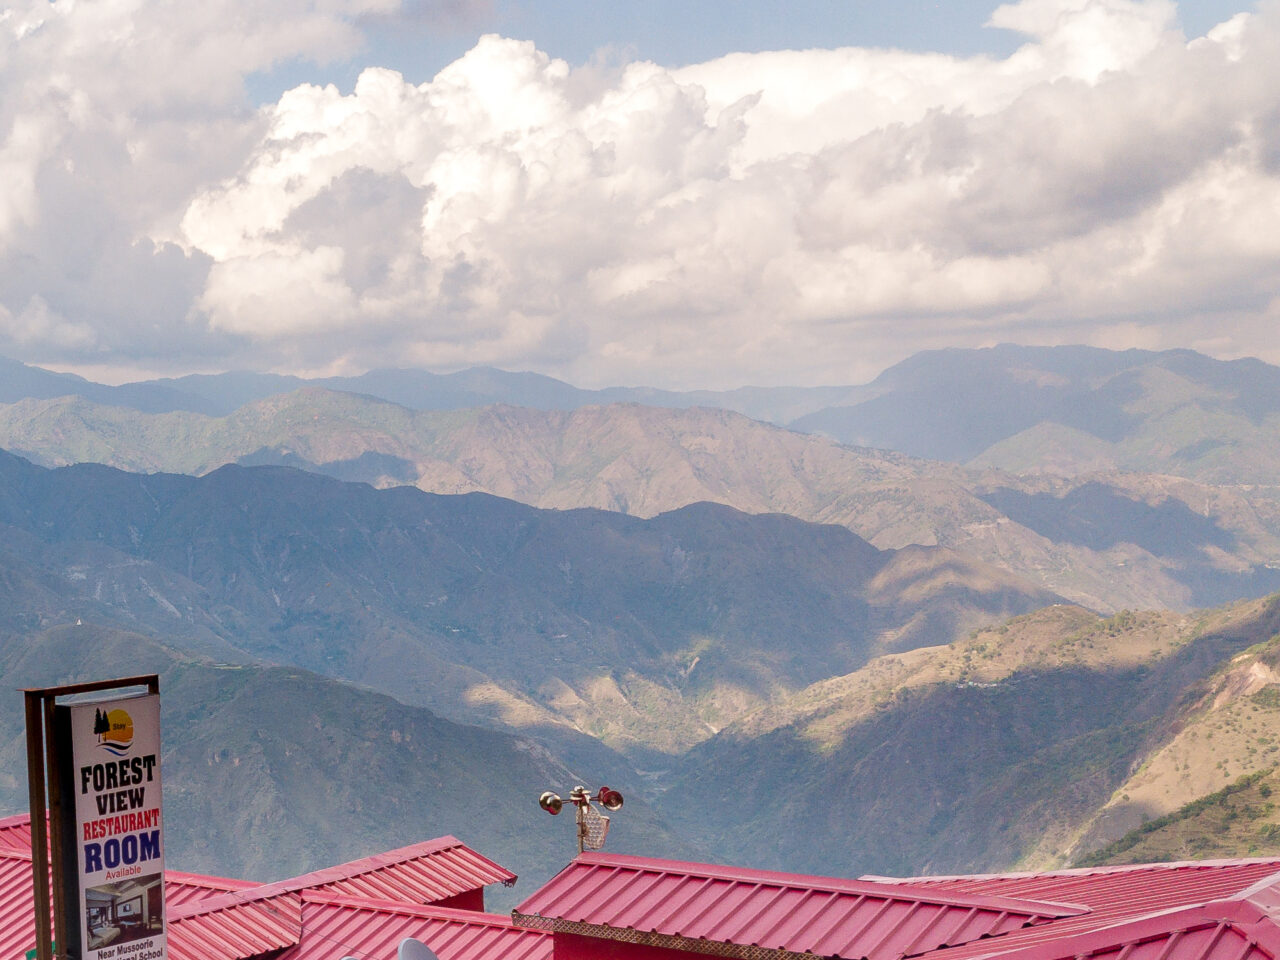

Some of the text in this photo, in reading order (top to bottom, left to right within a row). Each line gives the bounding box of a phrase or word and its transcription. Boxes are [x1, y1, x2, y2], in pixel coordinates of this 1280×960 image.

[112, 723, 127, 731] Stay
[81, 754, 156, 795] FOREST
[96, 787, 145, 816] VIEW
[83, 808, 160, 841] RESTAURANT
[84, 830, 161, 873] ROOM
[105, 865, 142, 881] Available
[97, 938, 154, 960] Near Mussoorie
